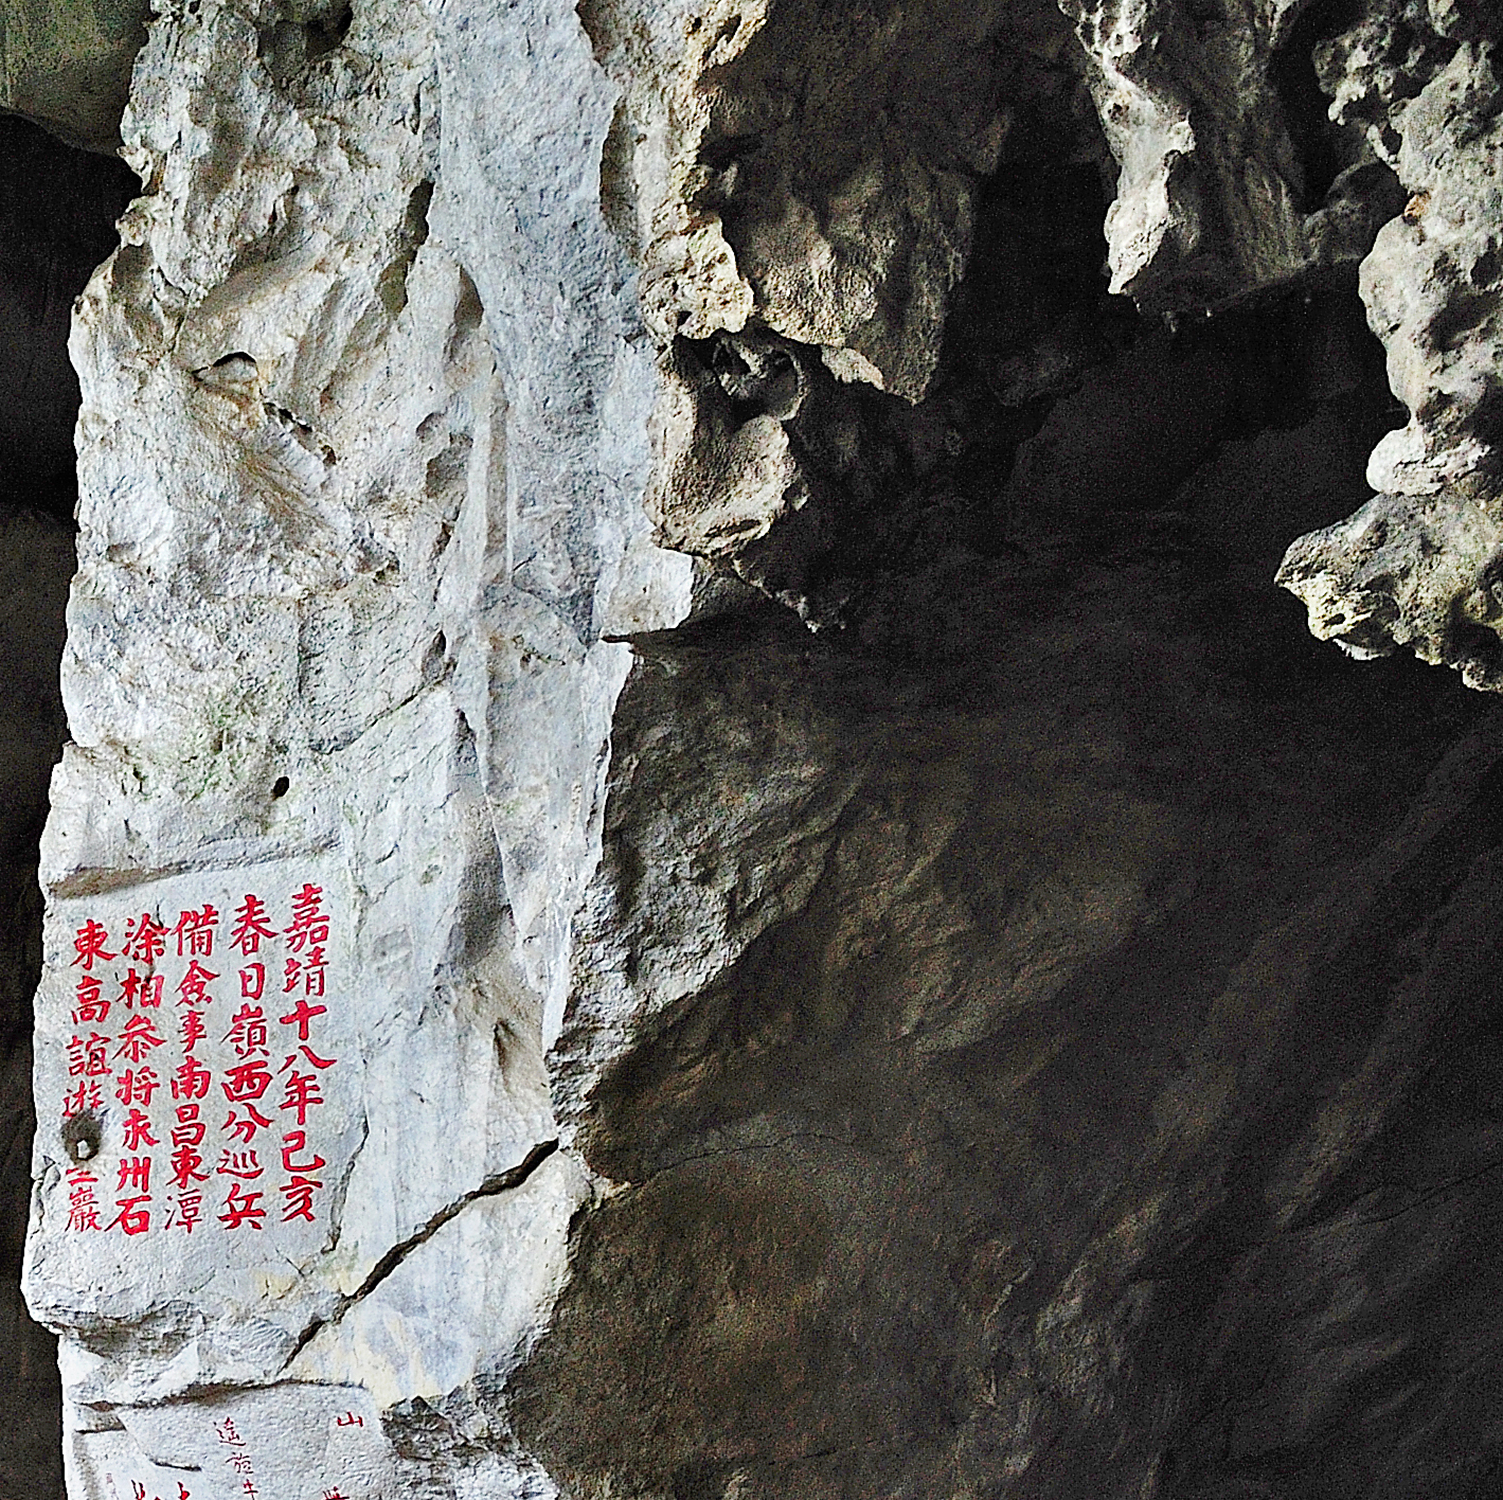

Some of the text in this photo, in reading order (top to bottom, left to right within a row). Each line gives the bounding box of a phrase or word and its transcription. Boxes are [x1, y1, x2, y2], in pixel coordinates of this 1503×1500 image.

[217, 894, 278, 1230] 春日嶺西分巡兵
[278, 883, 338, 1222] 嘉靖十八年己亥
